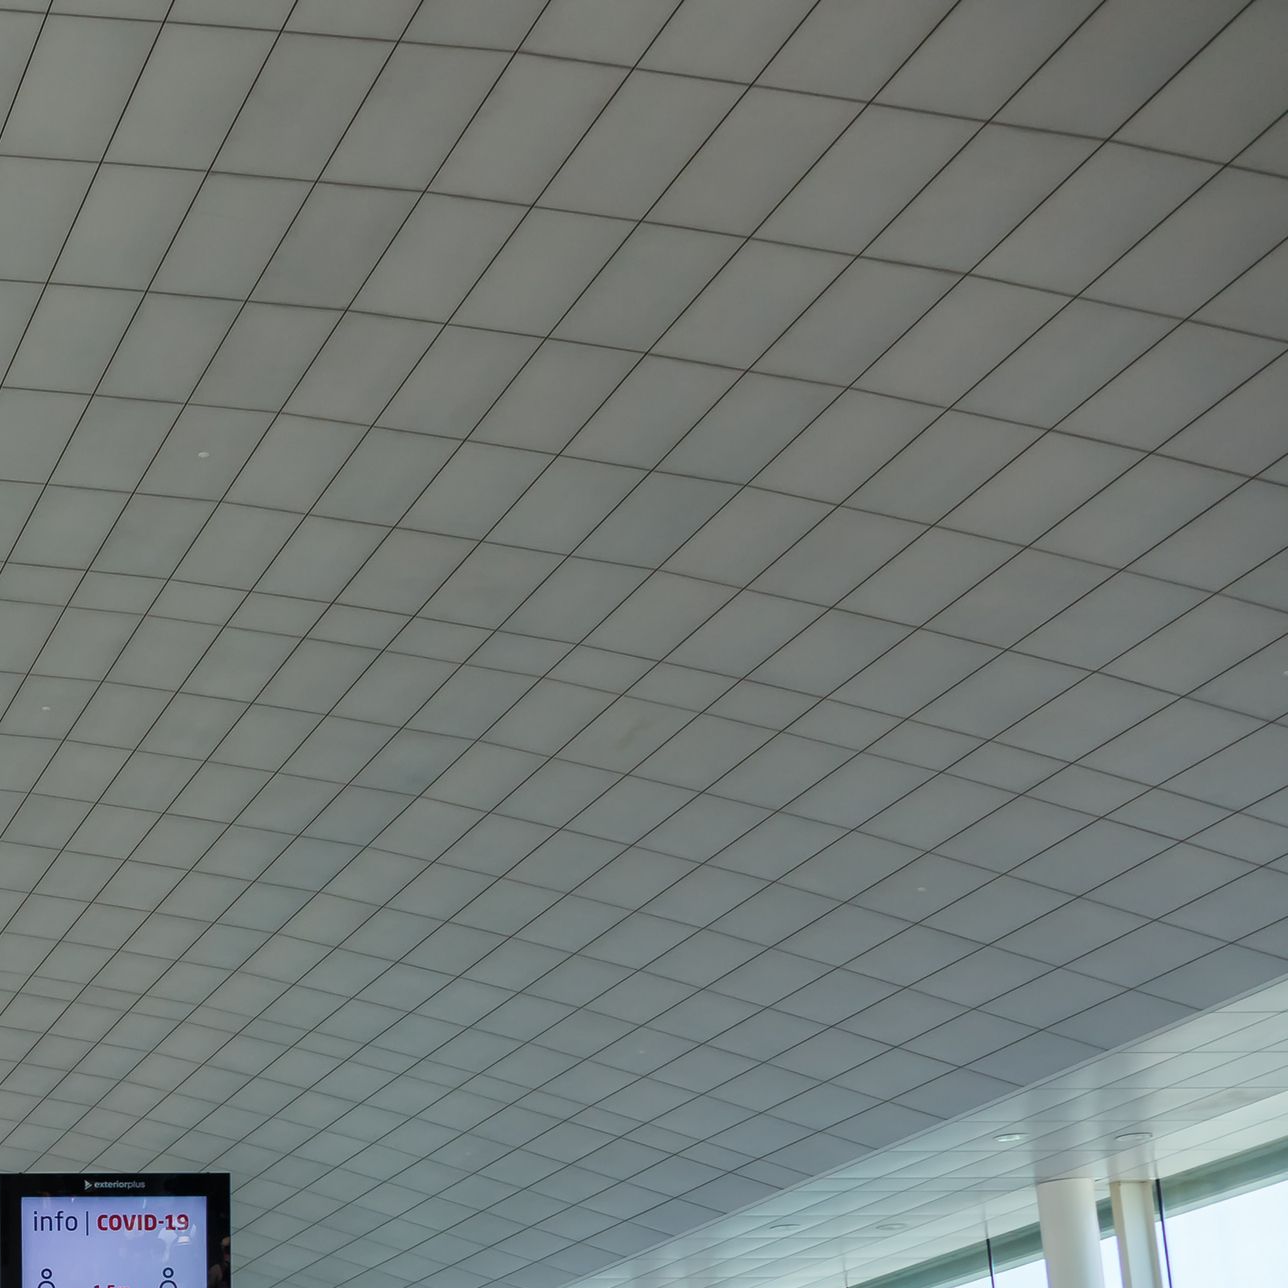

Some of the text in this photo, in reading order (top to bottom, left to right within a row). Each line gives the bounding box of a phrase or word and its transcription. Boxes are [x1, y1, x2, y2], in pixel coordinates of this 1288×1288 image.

[94, 1180, 145, 1190] exteriorplus
[33, 1211, 189, 1231] info COVID-19
